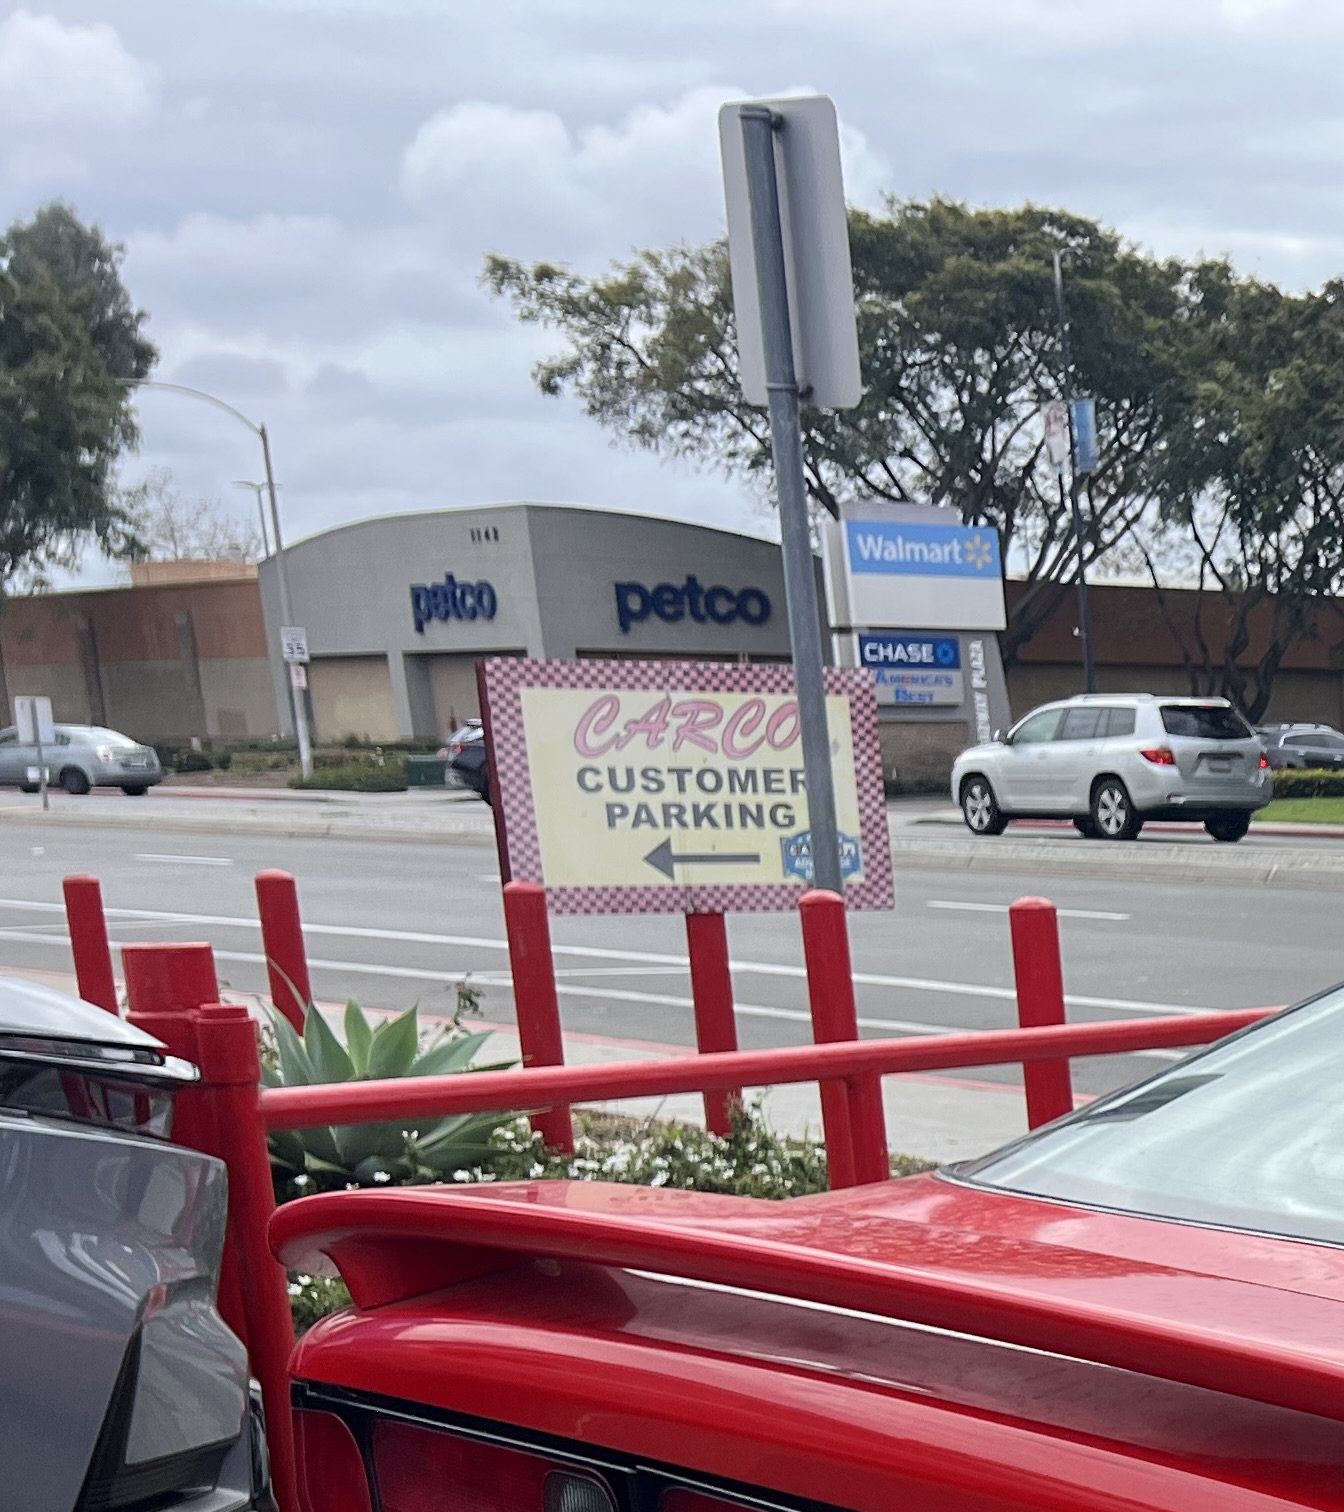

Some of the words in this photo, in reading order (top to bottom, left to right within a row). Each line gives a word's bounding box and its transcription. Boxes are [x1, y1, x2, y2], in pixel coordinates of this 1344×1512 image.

[856, 533, 963, 564] Walmart
[410, 571, 497, 634] petco
[615, 574, 772, 634] petco
[864, 642, 934, 663] CHASE
[573, 694, 801, 760] CARCO
[576, 766, 808, 794] CUSTOMER
[605, 802, 796, 830] PARKING
